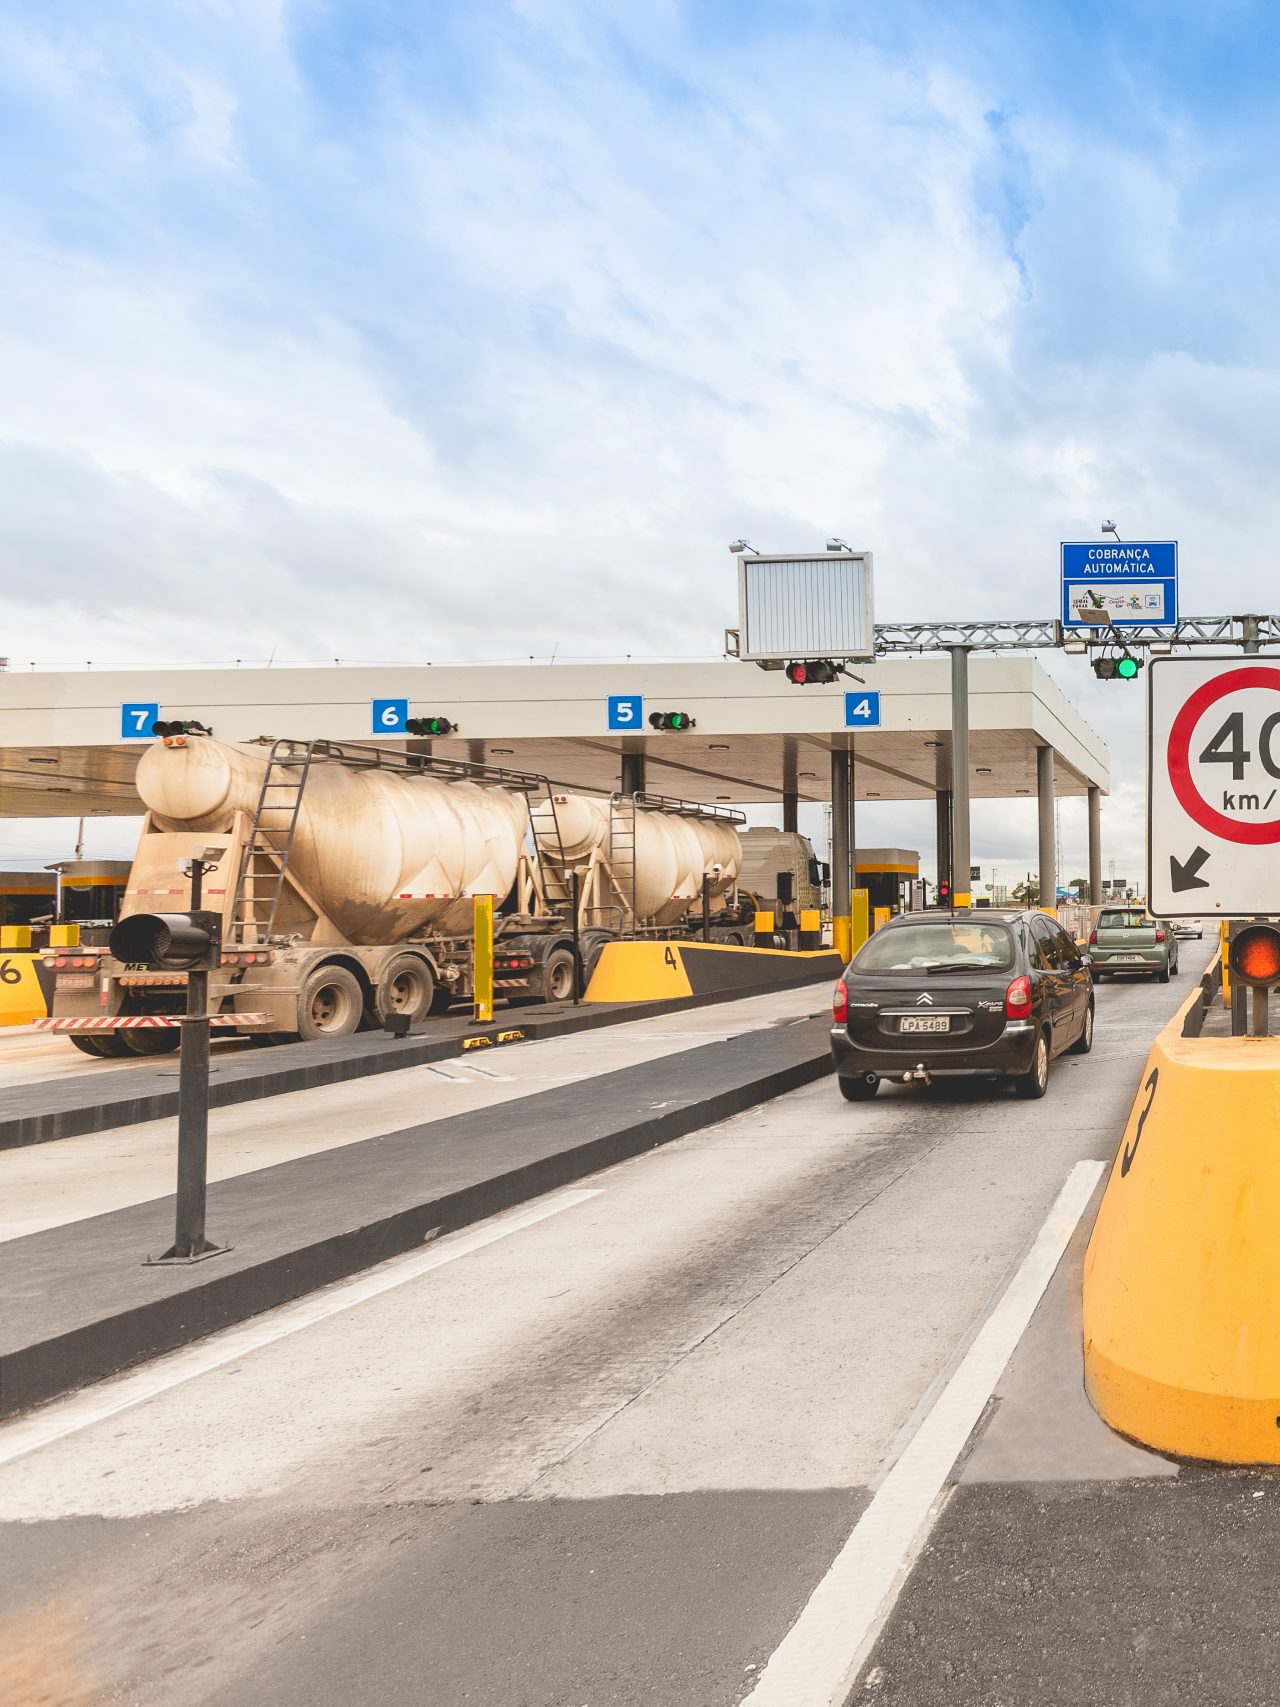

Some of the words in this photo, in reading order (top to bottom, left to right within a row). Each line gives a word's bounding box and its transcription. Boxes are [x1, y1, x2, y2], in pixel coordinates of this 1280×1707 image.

[1088, 549, 1150, 561] COBRANÇA
[1083, 561, 1155, 573] AUTOMÁTICA
[381, 706, 399, 726] 6
[617, 702, 634, 722] 5
[853, 699, 872, 718] 4
[131, 711, 149, 731] 7
[664, 946, 677, 970] 4
[0, 959, 22, 985] 6
[1121, 1066, 1159, 1178] 3
